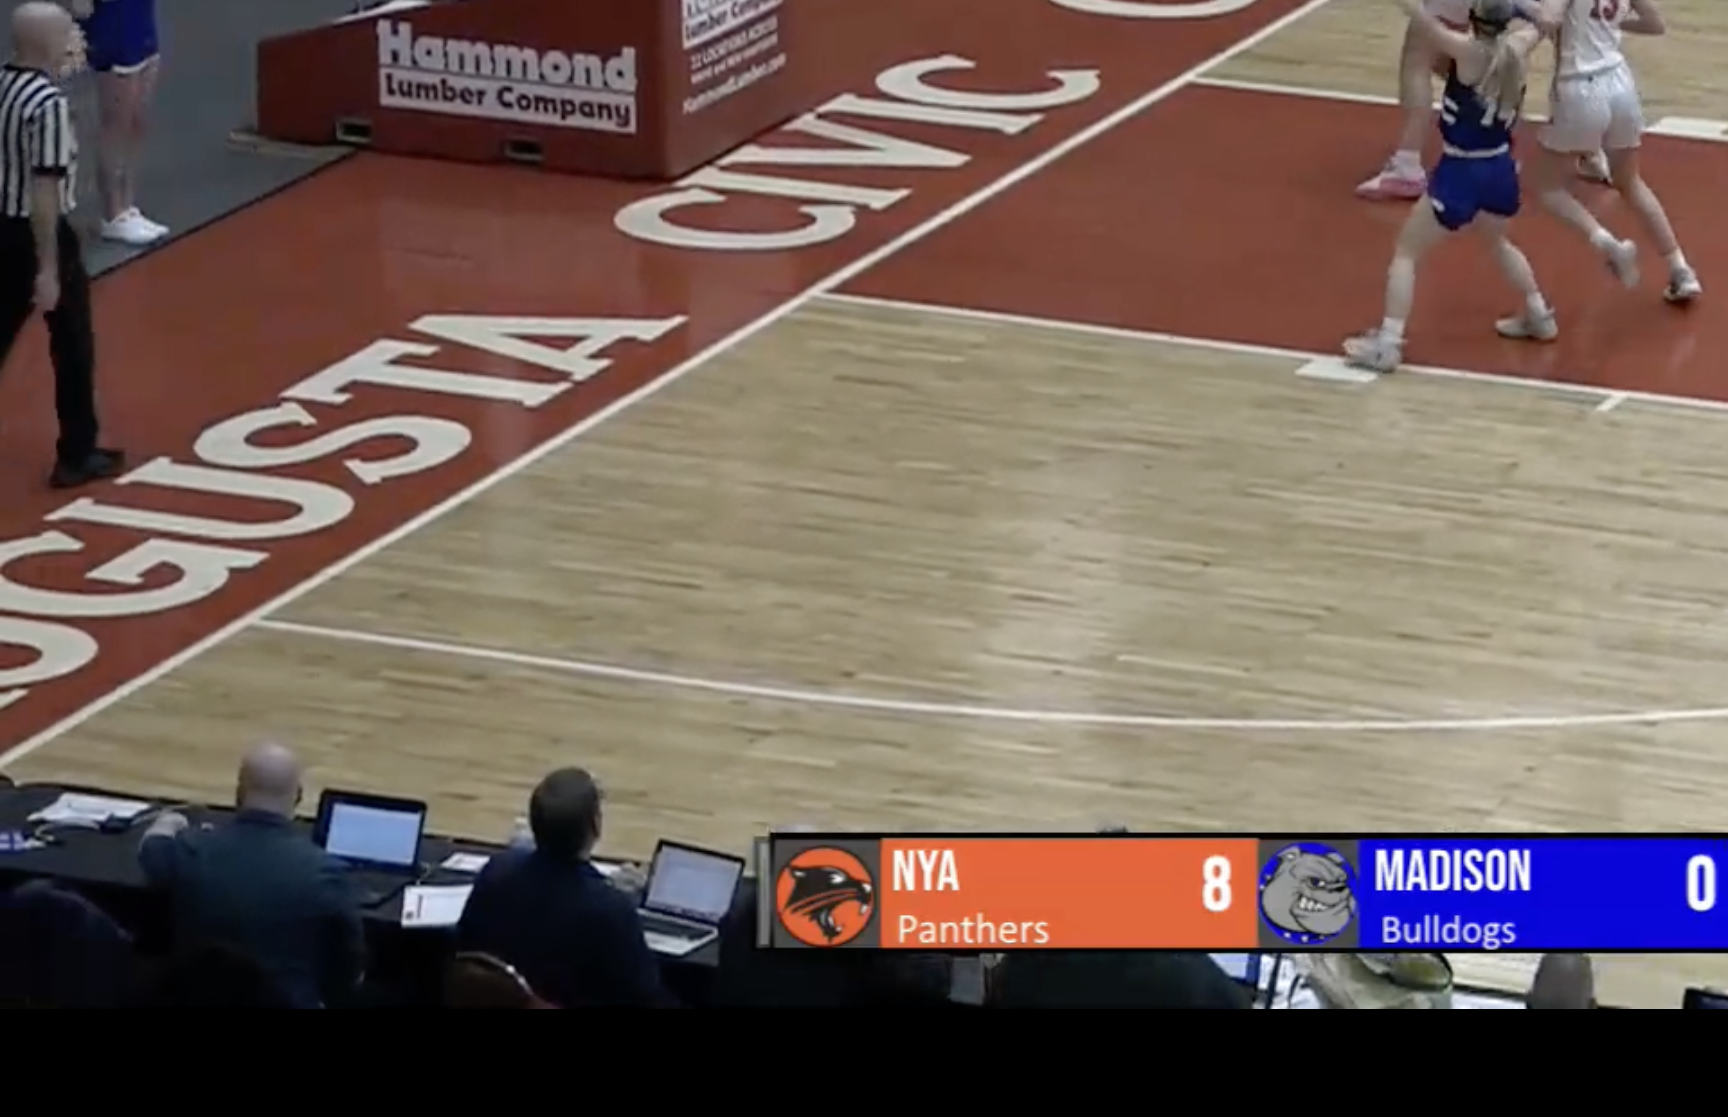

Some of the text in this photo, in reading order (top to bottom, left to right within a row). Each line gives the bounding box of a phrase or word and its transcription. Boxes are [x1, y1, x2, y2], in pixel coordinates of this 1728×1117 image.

[377, 19, 637, 94] Hammond
[385, 72, 631, 127] Lumber Company
[614, 55, 1101, 250] CIVIC
